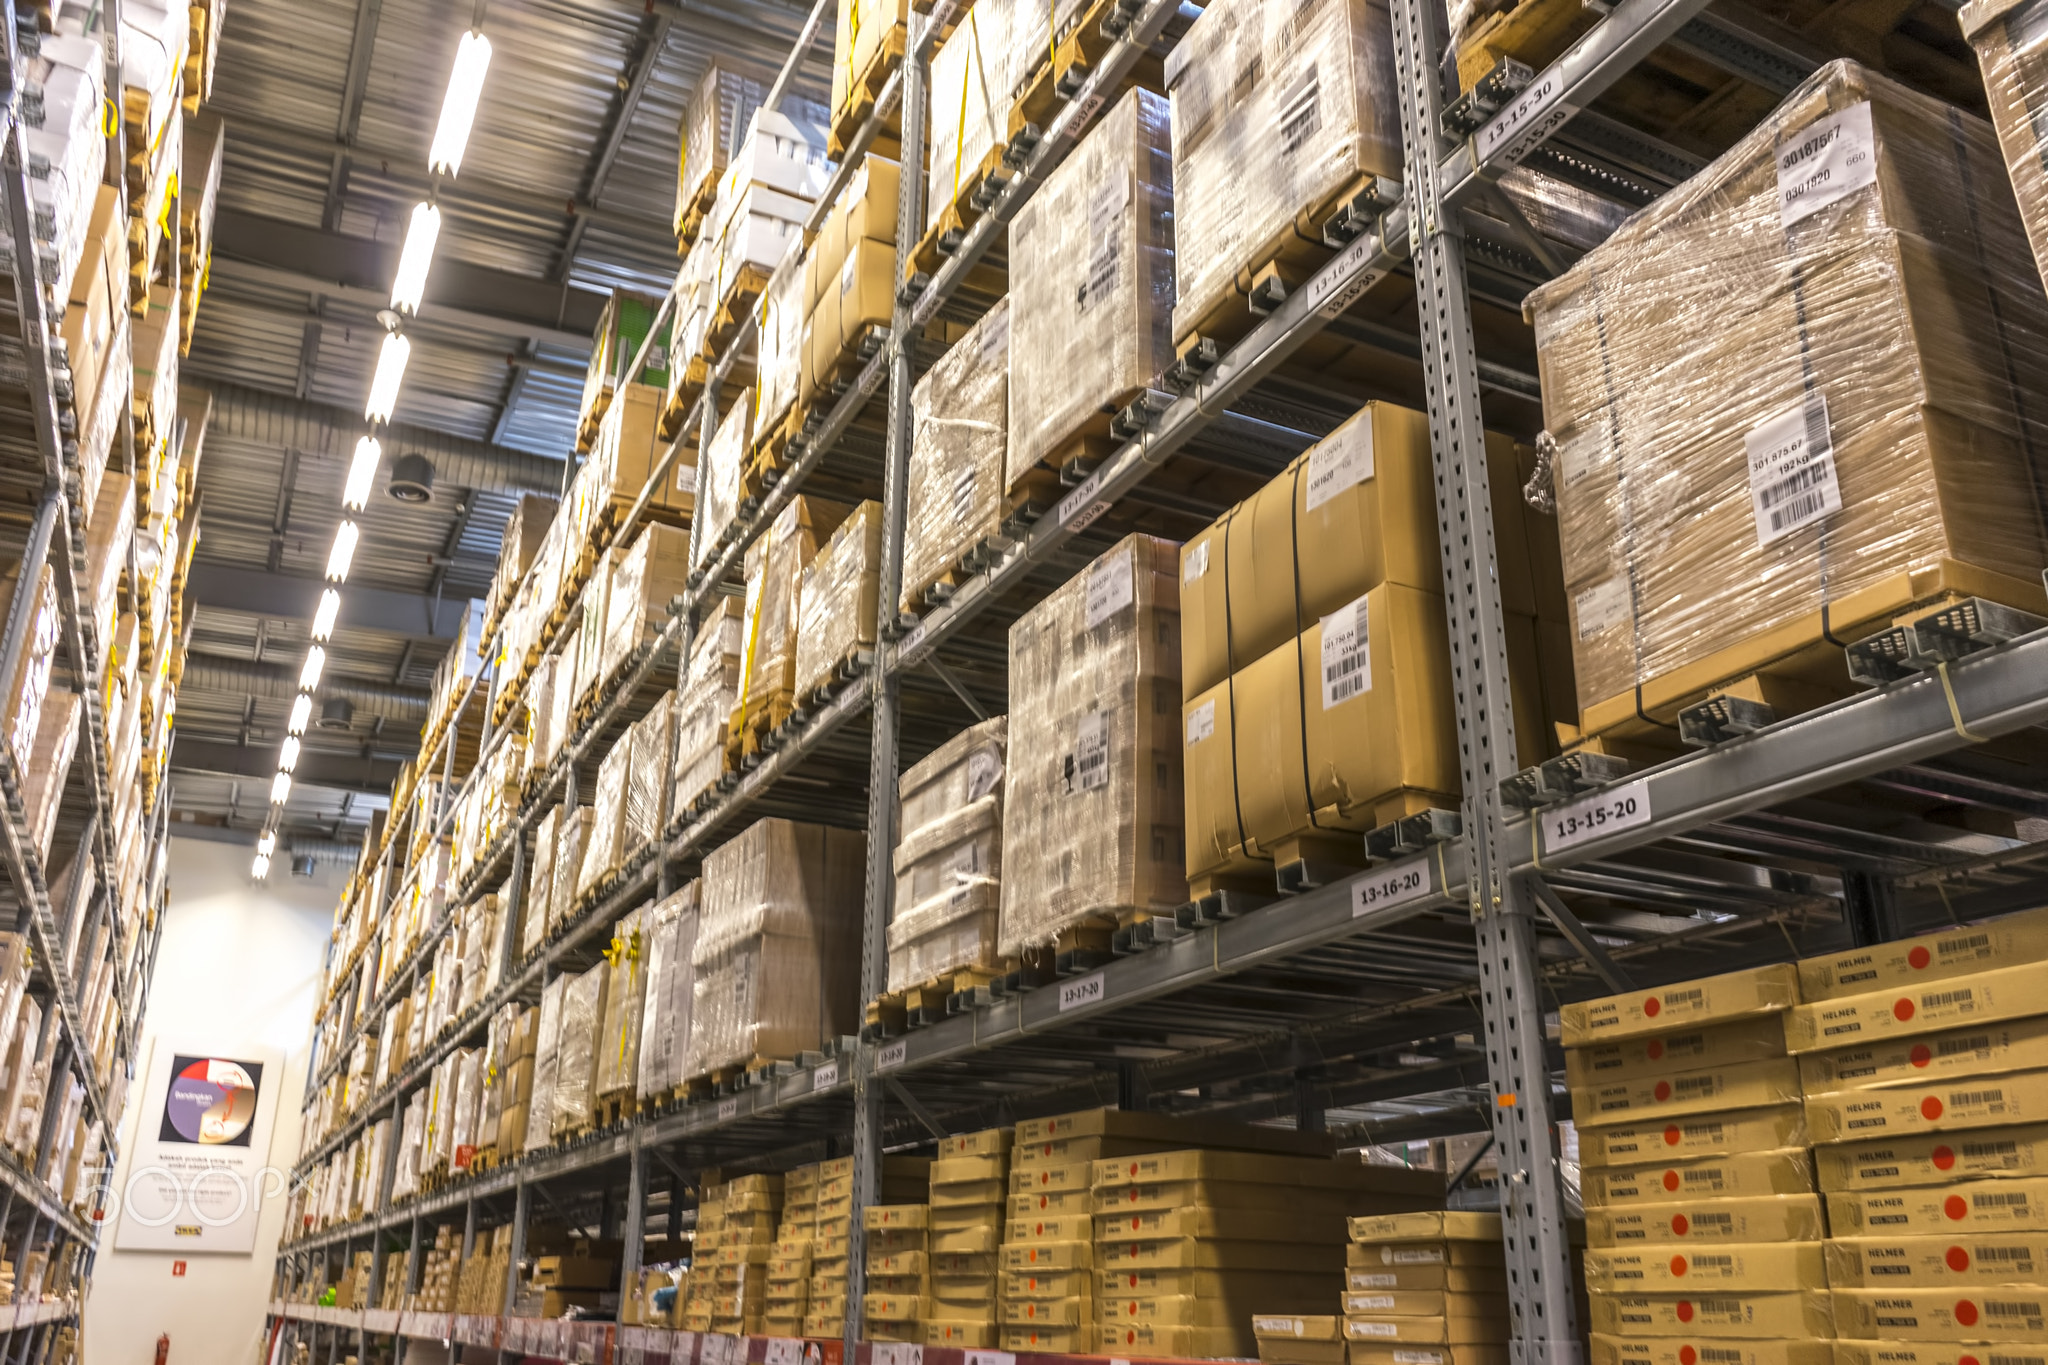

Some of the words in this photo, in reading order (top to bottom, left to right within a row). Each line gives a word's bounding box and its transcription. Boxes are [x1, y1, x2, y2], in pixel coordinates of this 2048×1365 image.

[1488, 81, 1552, 144] 13-15-30
[1505, 110, 1566, 162] 13-15-30
[1783, 124, 1841, 169] 30187567
[1846, 152, 1866, 167] 660
[1785, 169, 1830, 202] 0301820
[1315, 246, 1363, 295] 13-16-30
[1753, 439, 1803, 472] 301.875.67
[1557, 797, 1637, 838] 13-15-20
[1360, 871, 1420, 905] 13-16-20
[1837, 955, 1873, 971] HELMER
[1822, 1007, 1857, 1021] HELMER
[1838, 1052, 1873, 1065] HELMER
[1846, 1101, 1882, 1113] HELMER
[1858, 1150, 1894, 1162] HELMER
[1867, 1198, 1904, 1209] HELMER
[1868, 1247, 1906, 1258] HELMER
[1874, 1299, 1913, 1310] HELMER
[1878, 1351, 1917, 1362] HELMER
